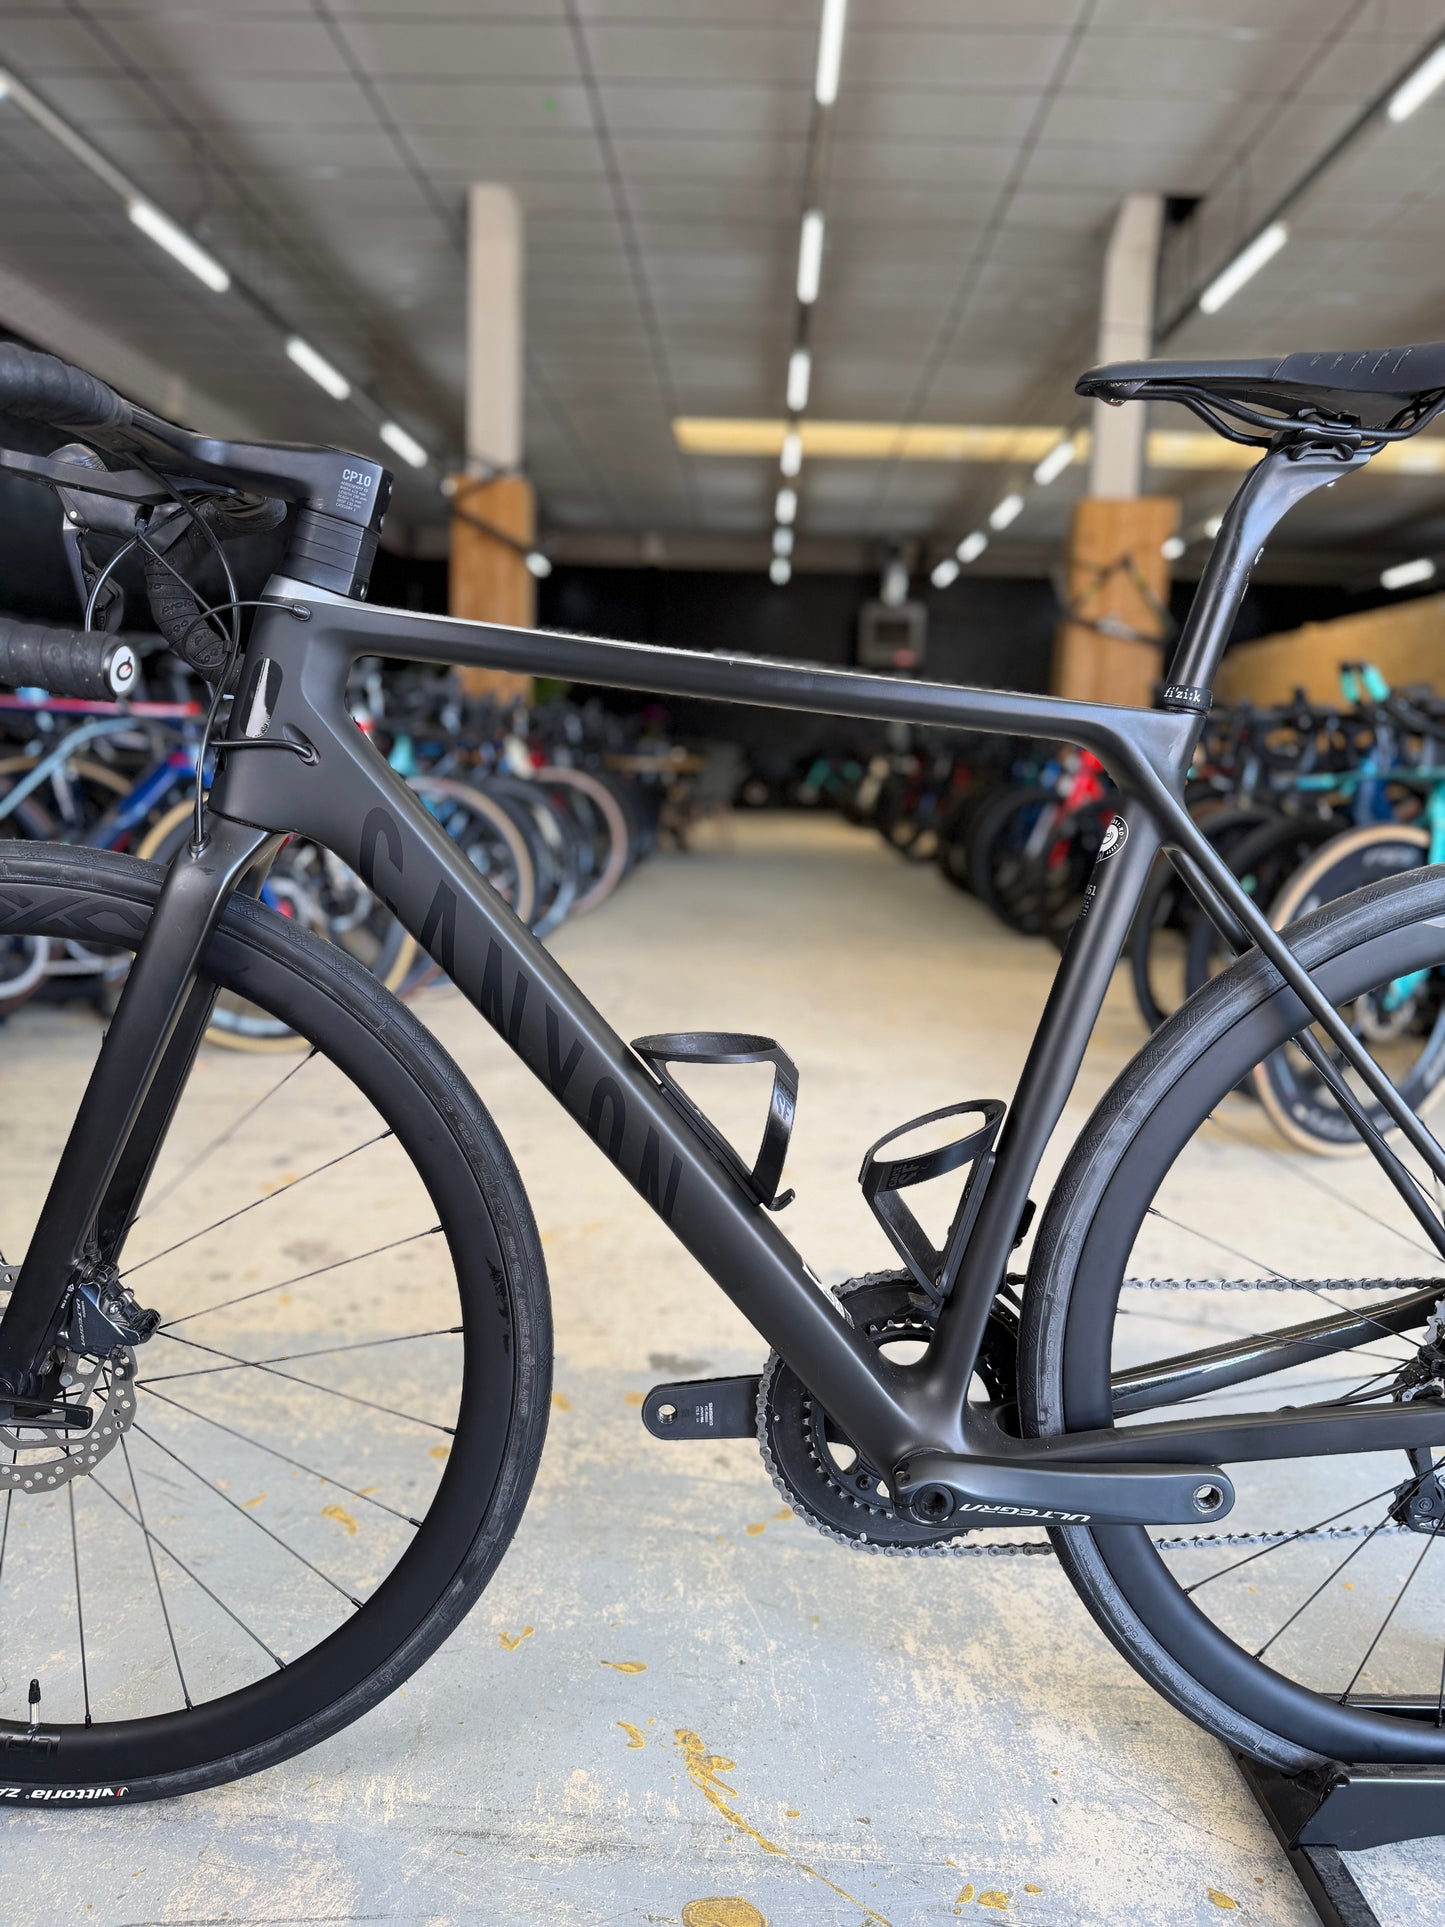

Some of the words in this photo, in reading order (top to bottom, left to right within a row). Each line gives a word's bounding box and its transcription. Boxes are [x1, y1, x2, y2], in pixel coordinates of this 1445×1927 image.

[342, 468, 371, 487] CP10
[360, 807, 682, 1221] CANYON
[959, 1503, 1091, 1522] ULTEGRA
